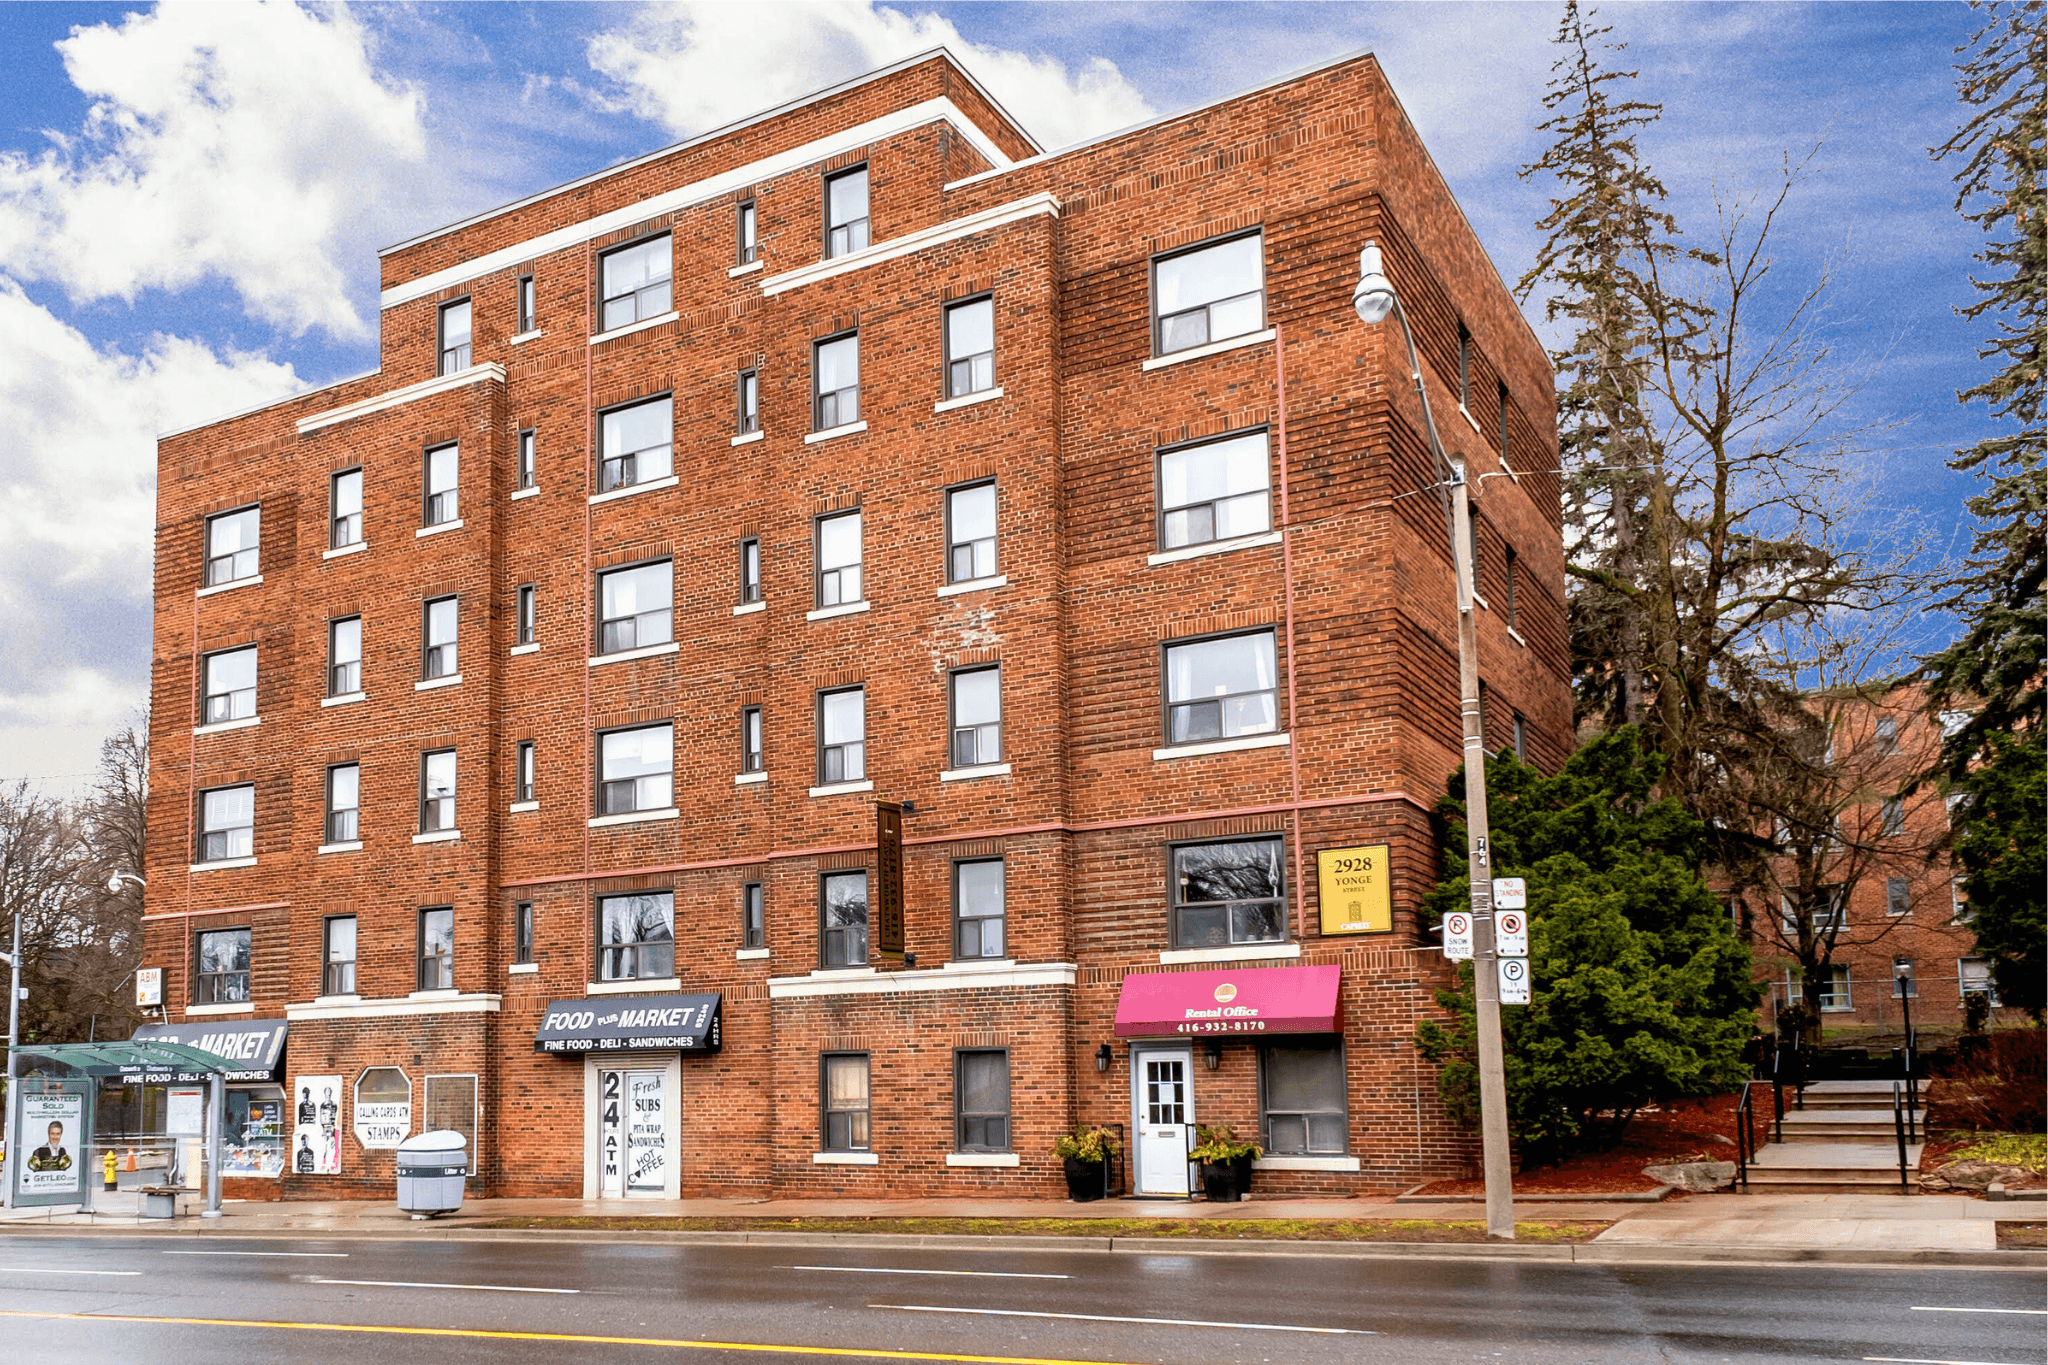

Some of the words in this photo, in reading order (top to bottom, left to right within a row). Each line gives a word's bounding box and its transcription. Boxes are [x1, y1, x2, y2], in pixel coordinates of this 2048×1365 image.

[1334, 856, 1372, 873] 2928
[1335, 875, 1372, 886] YONGE
[889, 839, 898, 938] 416-932-8170
[1447, 947, 1469, 955] ROUTE
[140, 971, 157, 983] ABM
[544, 1012, 594, 1030] FOOD
[597, 1013, 619, 1026] PLUS
[617, 1008, 695, 1028] MARKET
[1185, 1007, 1221, 1018] Rental
[1223, 1006, 1258, 1017] Office
[1177, 1021, 1266, 1032] 416-932-8170
[200, 1032, 270, 1060] MARKET
[544, 1041, 565, 1050] FINE
[566, 1040, 593, 1050] FOOD
[600, 1038, 622, 1049] DELI
[629, 1037, 693, 1047] SANDWICHES
[123, 1075, 143, 1084] FINE
[145, 1073, 171, 1083] FOOD
[178, 1072, 199, 1082] DELI
[206, 1070, 270, 1081] SDWICHES
[632, 1076, 660, 1101] Fresh
[635, 1099, 660, 1111] SUBS
[359, 1107, 379, 1118] CALLING
[380, 1107, 396, 1118] CARDS
[399, 1107, 409, 1117] ATM
[367, 1126, 401, 1140] STAMPS
[633, 1124, 645, 1133] PITA
[646, 1124, 661, 1133] WRAP
[628, 1133, 664, 1148] SANDWICHES
[606, 1136, 617, 1175] ATM
[636, 1149, 654, 1166] HOT
